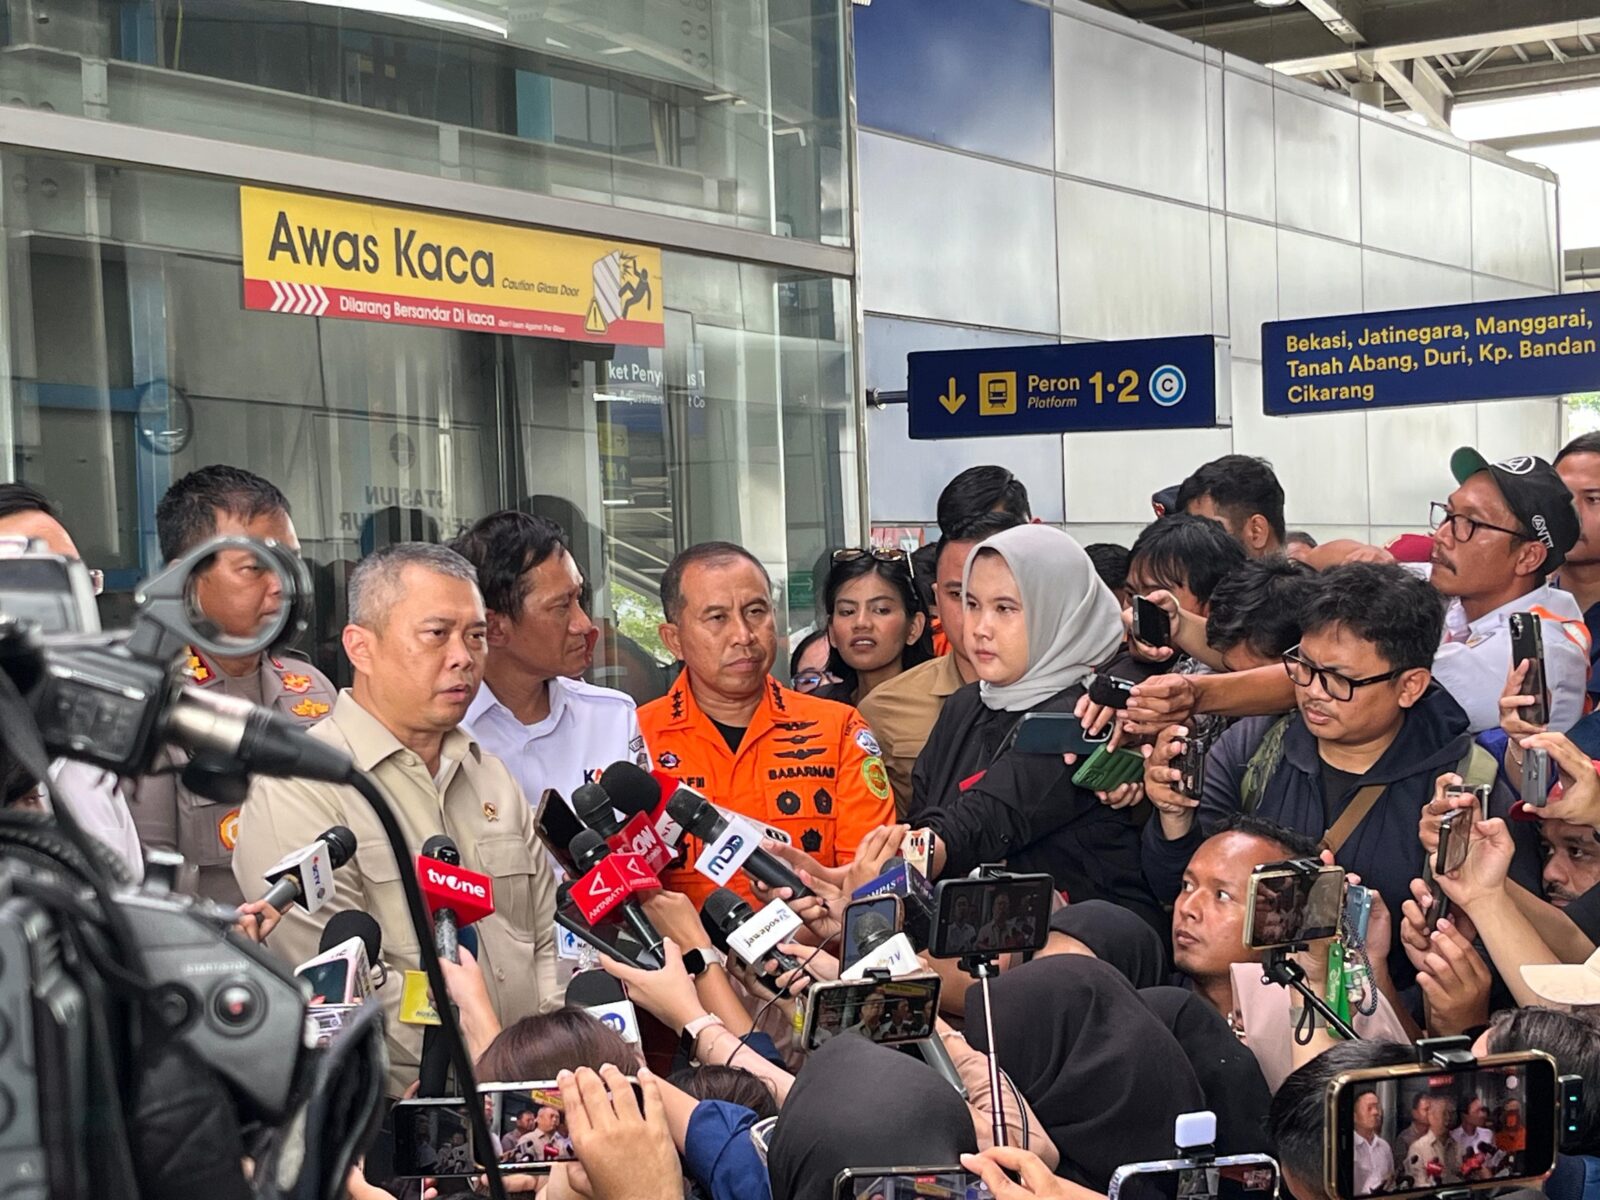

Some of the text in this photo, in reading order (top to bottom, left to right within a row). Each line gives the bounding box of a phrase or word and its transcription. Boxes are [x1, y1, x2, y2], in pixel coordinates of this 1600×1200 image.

[267, 210, 495, 288] Awas Kaca
[502, 277, 580, 297] Caution Glass Door
[339, 295, 495, 327] Dilarang Bersandar Di kaca
[1286, 308, 1593, 353] Bekasi, Jatinegara, Manggarai,
[1286, 336, 1597, 378] Tanah Abang, Duri, Kp. Bandan
[608, 360, 629, 380] ket
[1027, 374, 1080, 393] Peron
[1287, 382, 1375, 403] Cikarang
[1027, 396, 1078, 409] Platform
